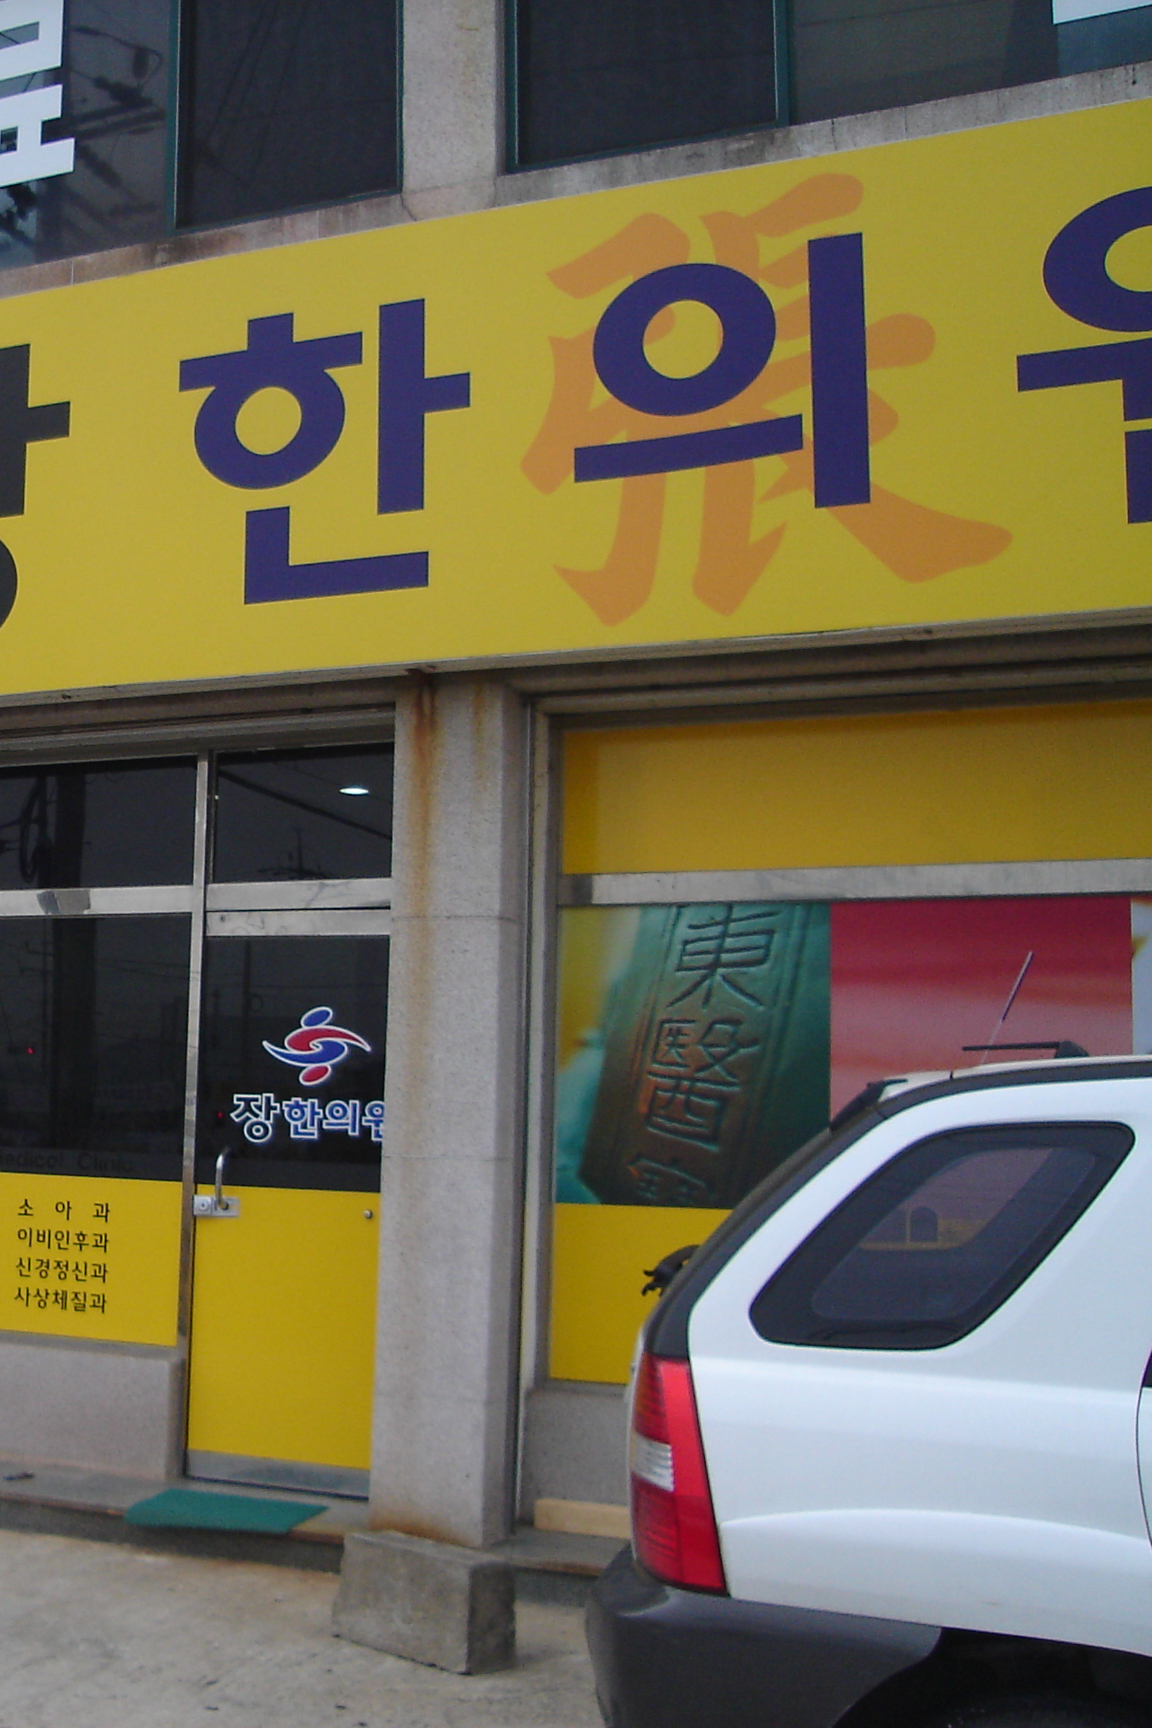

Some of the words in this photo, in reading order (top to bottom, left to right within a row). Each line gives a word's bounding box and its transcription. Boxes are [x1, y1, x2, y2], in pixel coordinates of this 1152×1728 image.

[18, 1227, 108, 1253] 이비인후과
[16, 1257, 108, 1284] 신경정신과
[14, 1287, 107, 1314] 사상체질과
